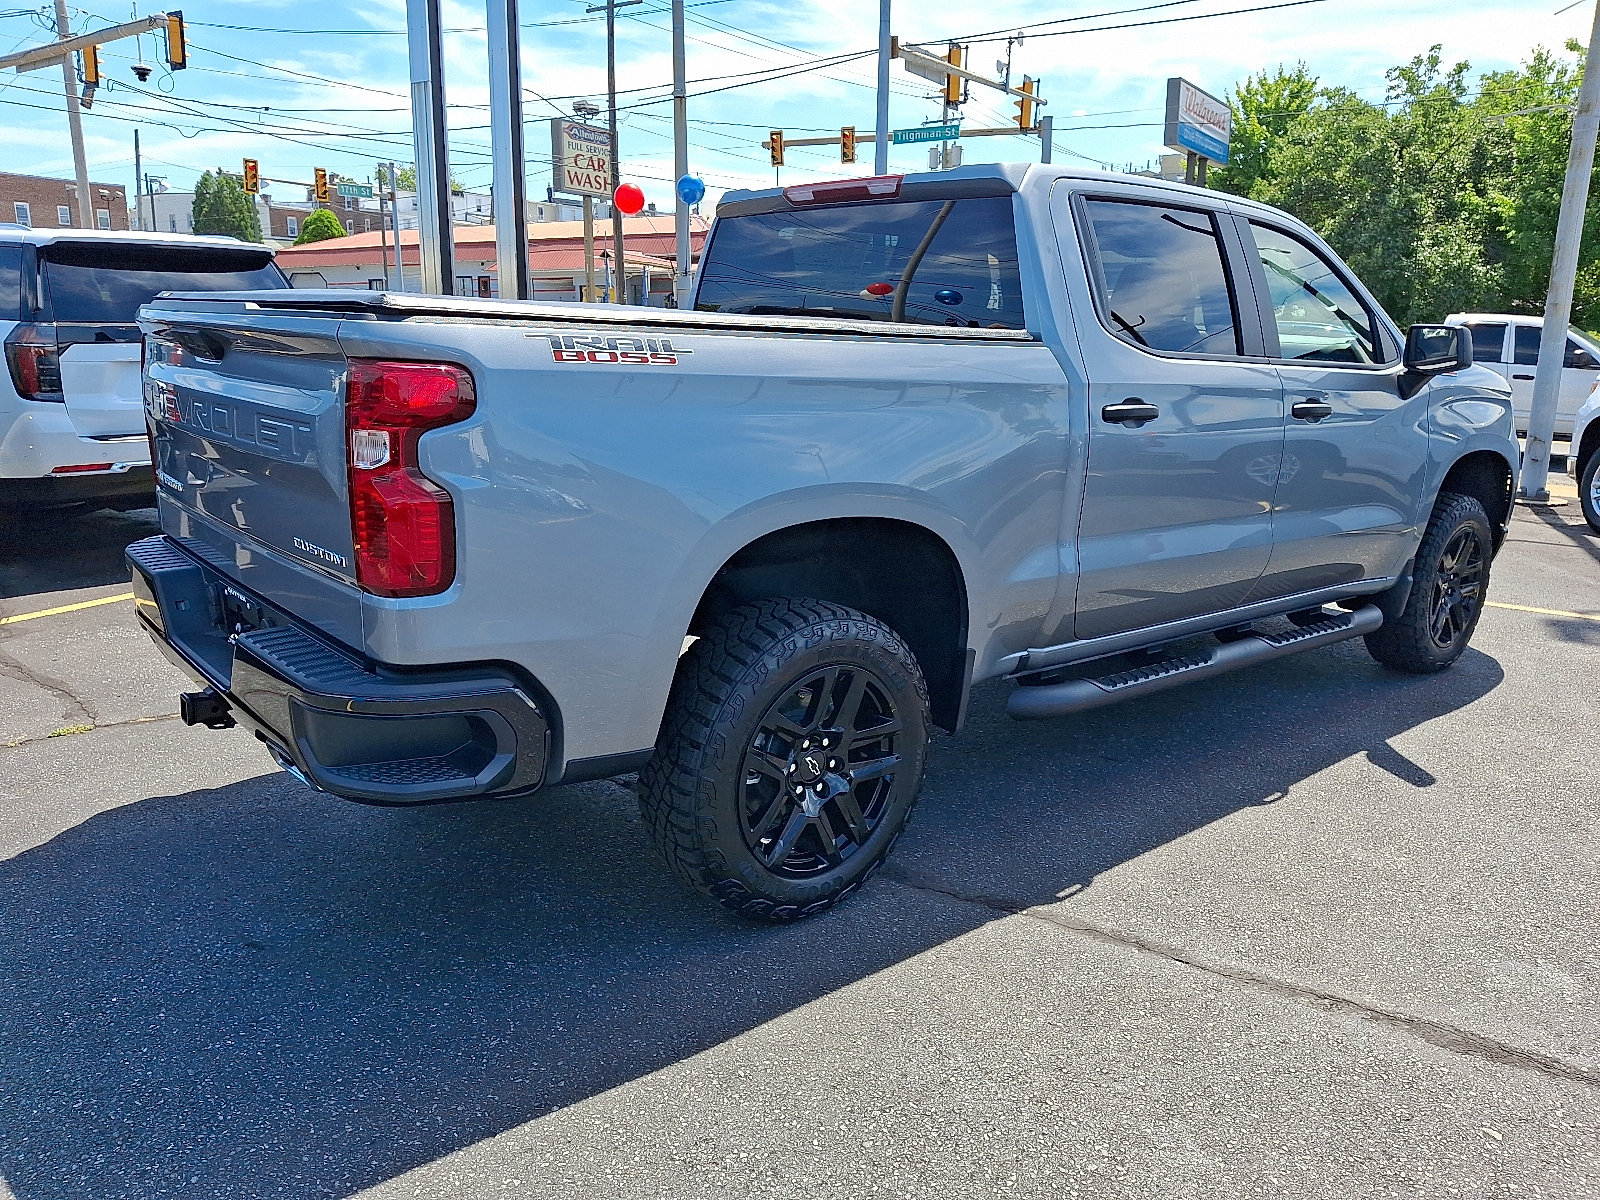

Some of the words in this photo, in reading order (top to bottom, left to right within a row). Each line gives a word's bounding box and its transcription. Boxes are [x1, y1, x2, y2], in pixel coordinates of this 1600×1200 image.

[897, 130, 941, 141] Tilghman
[945, 127, 956, 136] St
[567, 141, 583, 151] FULL
[586, 145, 611, 156] SERVIC
[574, 153, 606, 173] CAR
[340, 185, 358, 194] 17th
[361, 187, 370, 196] St
[523, 333, 695, 355] TRAIL
[552, 350, 678, 366] BOSS
[144, 378, 312, 457] CHEVROLET
[293, 536, 348, 568] CUSTOM
